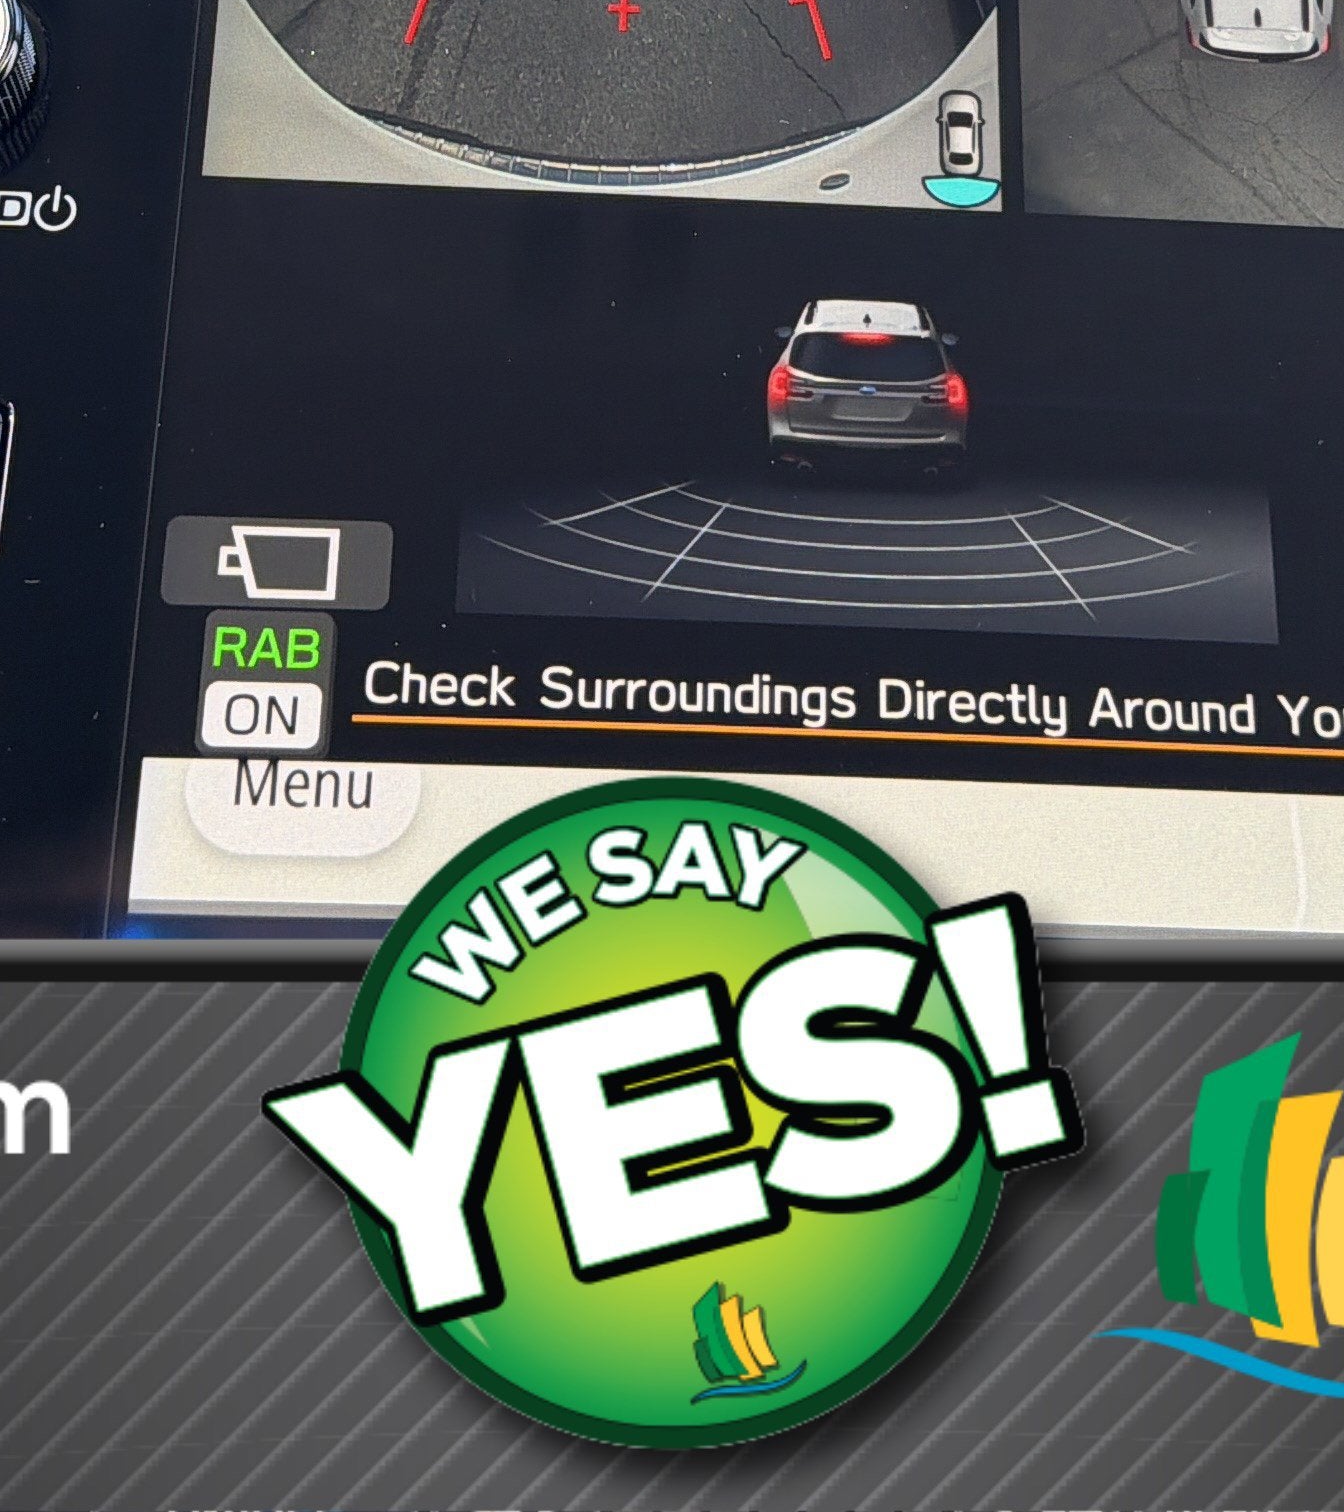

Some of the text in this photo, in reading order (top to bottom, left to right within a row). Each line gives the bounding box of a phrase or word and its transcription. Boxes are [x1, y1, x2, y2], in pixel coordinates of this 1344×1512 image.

[213, 626, 320, 669] RAB
[224, 694, 299, 736] ON
[365, 660, 515, 707] Check
[541, 666, 856, 728] Surroundings
[878, 678, 1068, 737] Directly
[1088, 687, 1256, 735] Around
[233, 759, 373, 810] Menu
